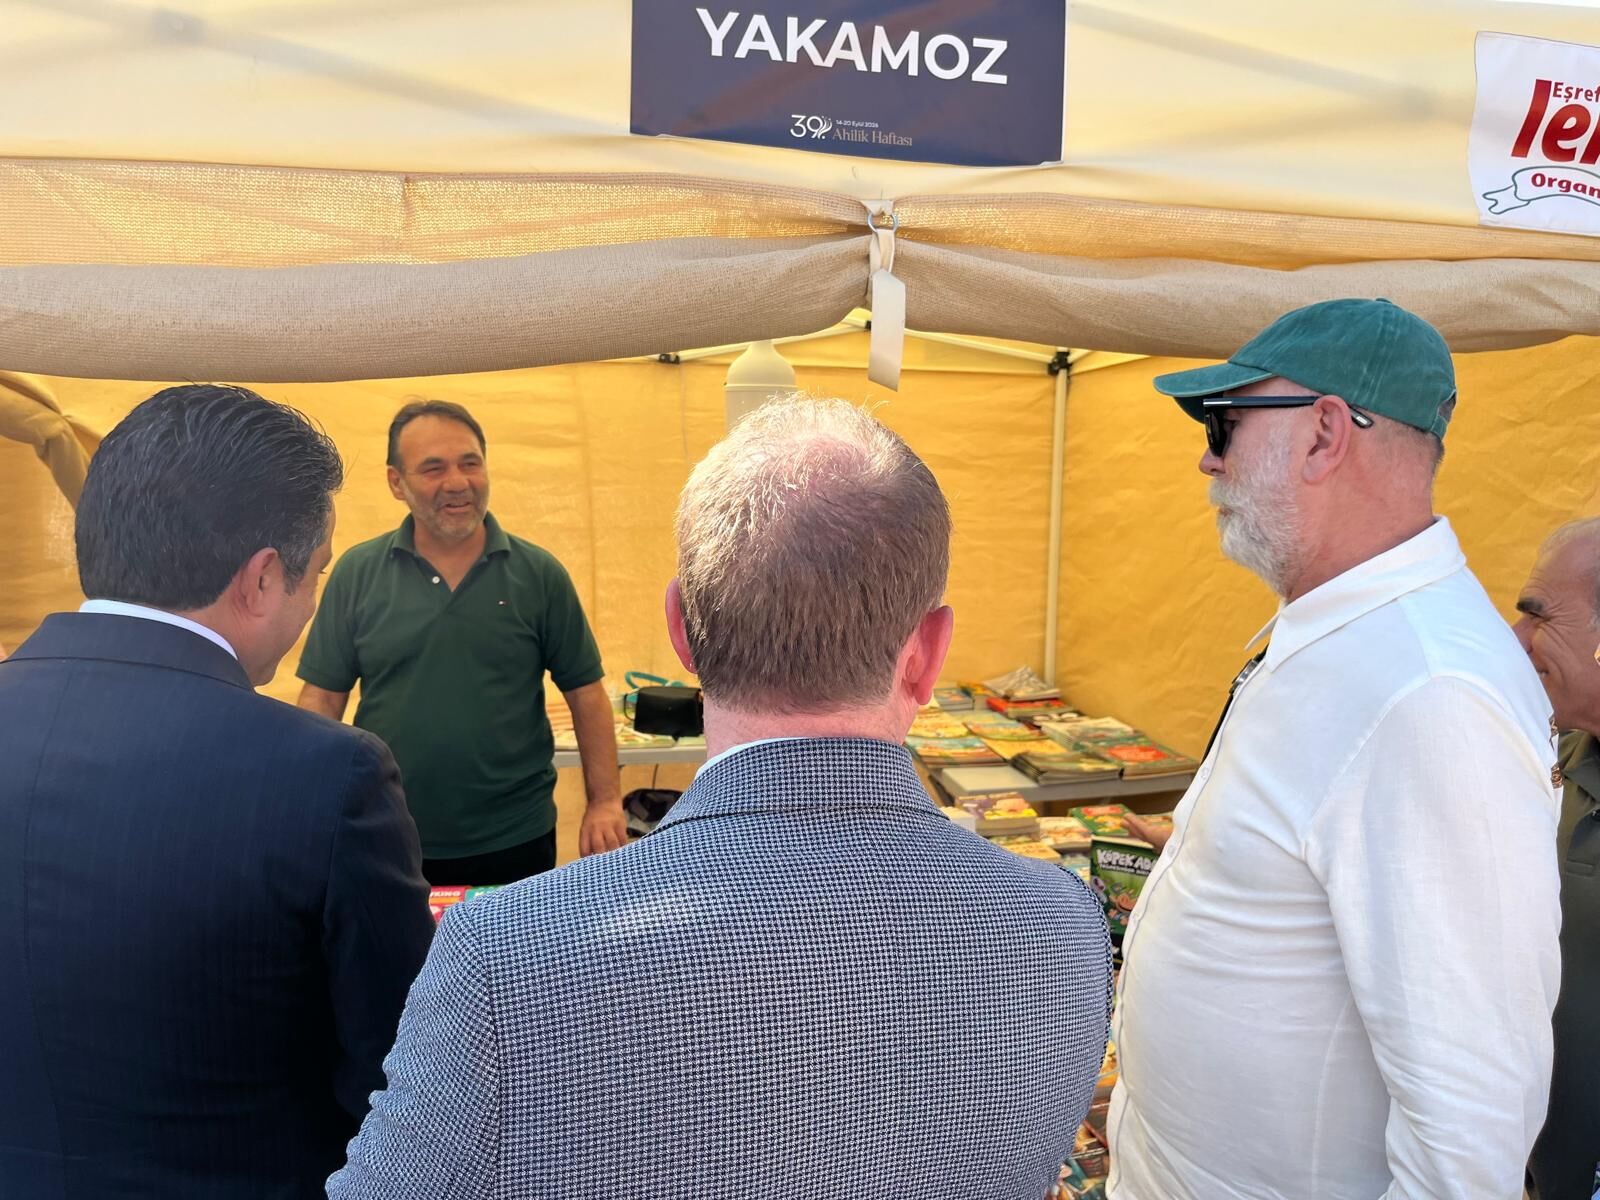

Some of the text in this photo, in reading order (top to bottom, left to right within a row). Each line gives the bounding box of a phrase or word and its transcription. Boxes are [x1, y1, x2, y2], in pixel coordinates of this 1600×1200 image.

[695, 7, 1009, 86] YAKAMOZ
[1551, 81, 1600, 103] Eşref
[832, 128, 913, 146] Ahilik Haftası
